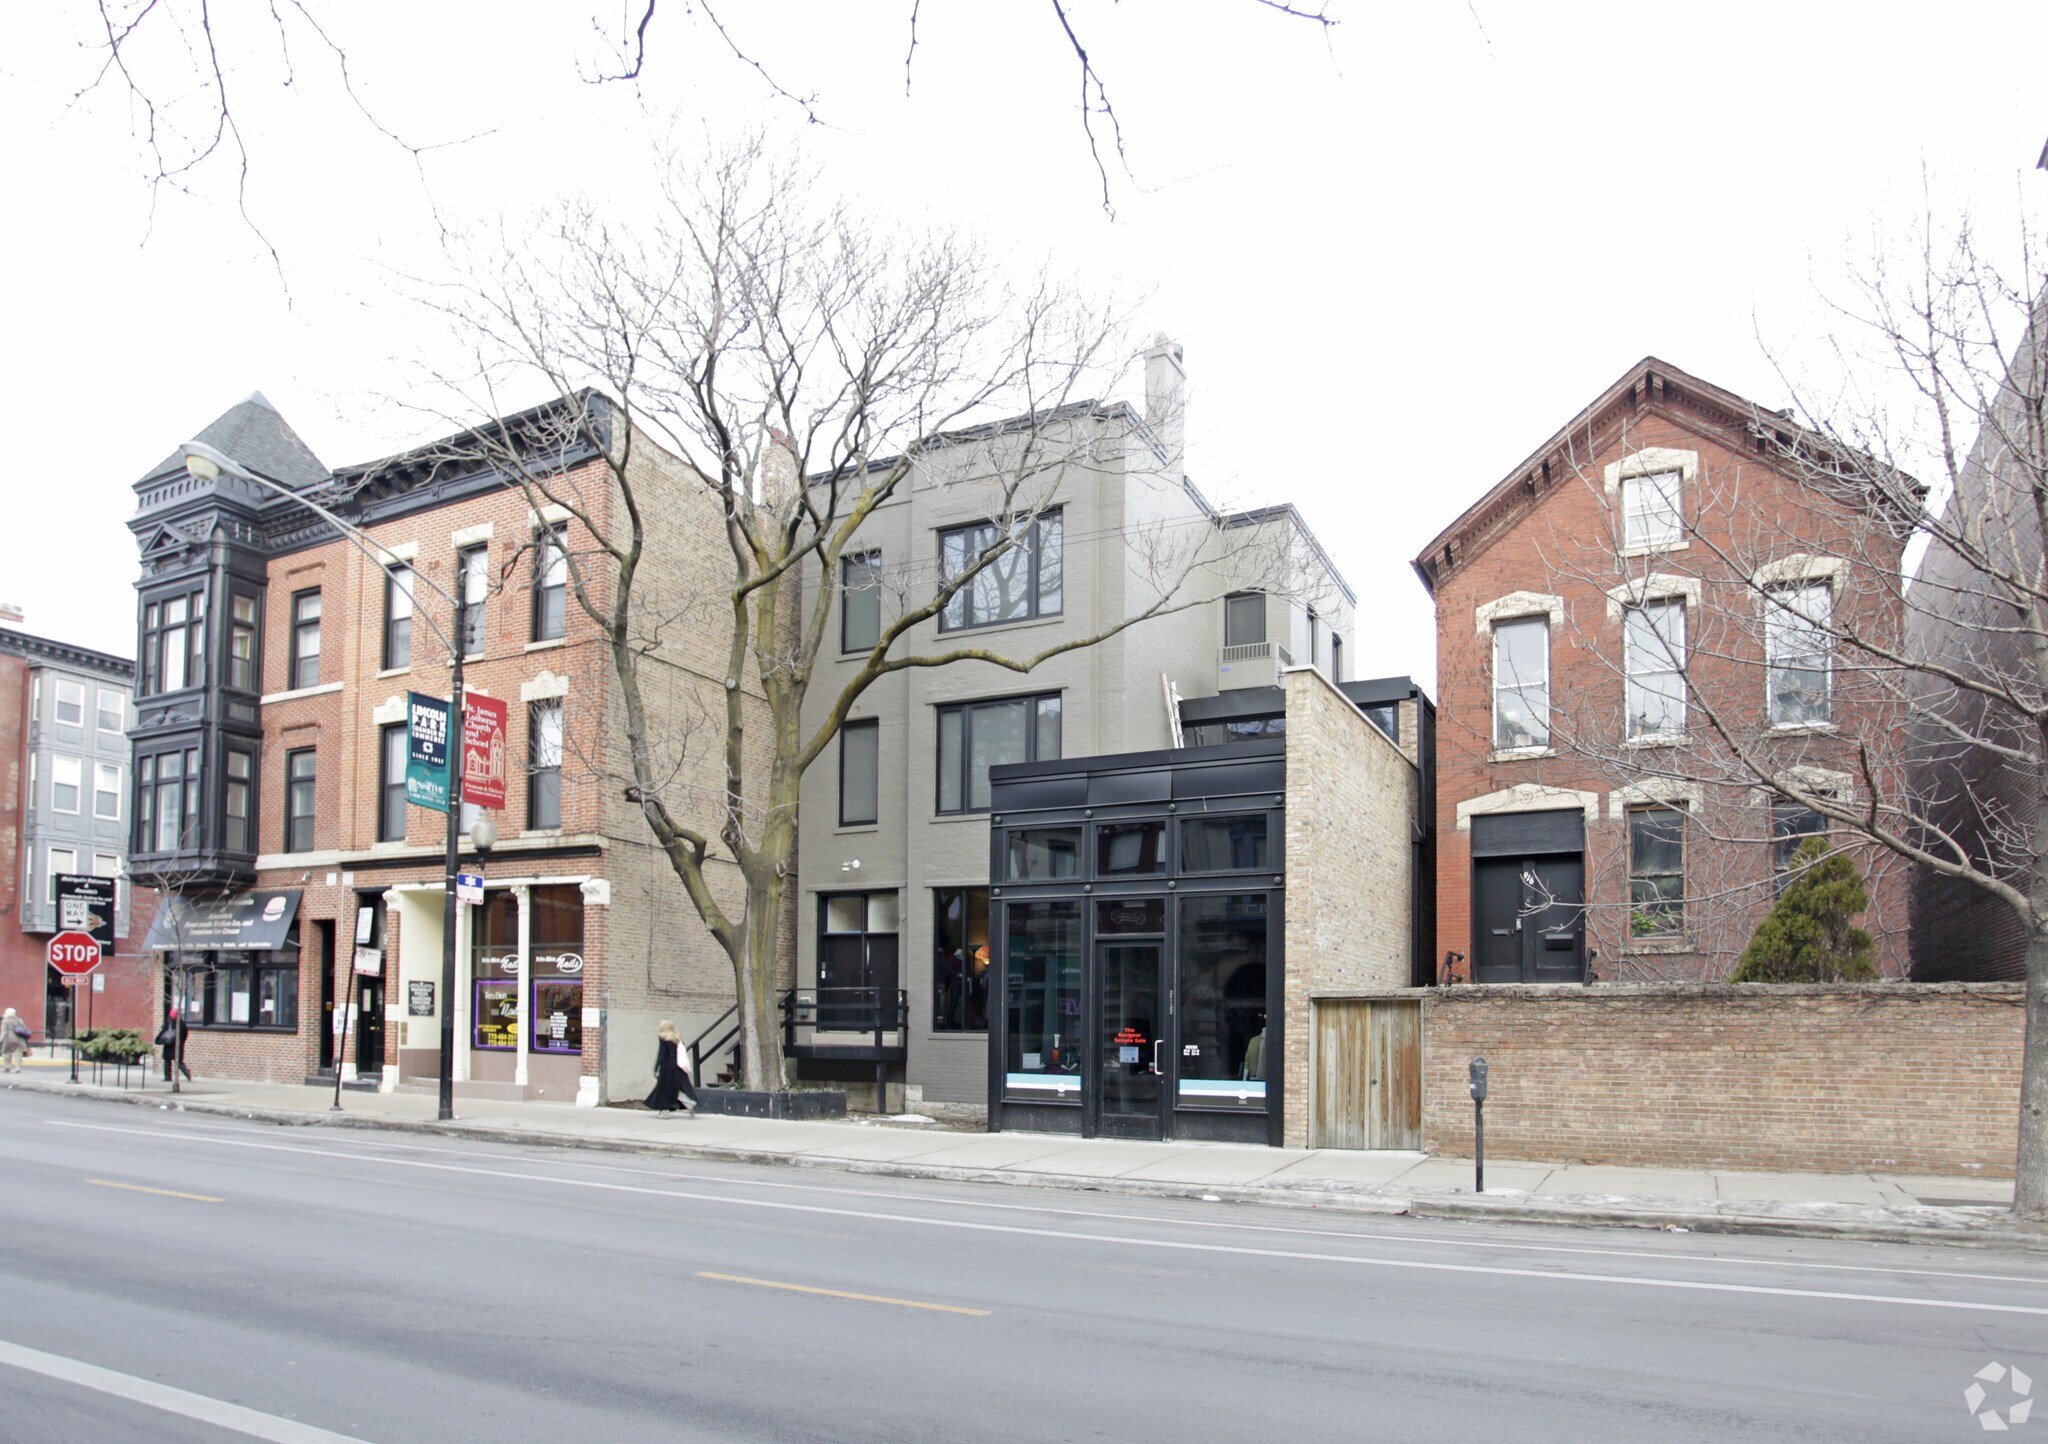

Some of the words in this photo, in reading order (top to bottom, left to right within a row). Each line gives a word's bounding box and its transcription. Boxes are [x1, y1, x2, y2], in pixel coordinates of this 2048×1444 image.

[412, 703, 447, 722] LINCOLN
[466, 703, 476, 712] St.
[477, 706, 497, 718] James
[466, 712, 498, 726] Lutheran
[412, 724, 437, 737] CHAMBER
[465, 720, 492, 733] Church
[412, 730, 446, 744] COMMERCE
[465, 729, 479, 738] and
[465, 736, 489, 748] School
[412, 752, 429, 761] SINCE
[1523, 871, 1534, 885] 916
[52, 944, 98, 962] STOP
[556, 957, 579, 969] Nails
